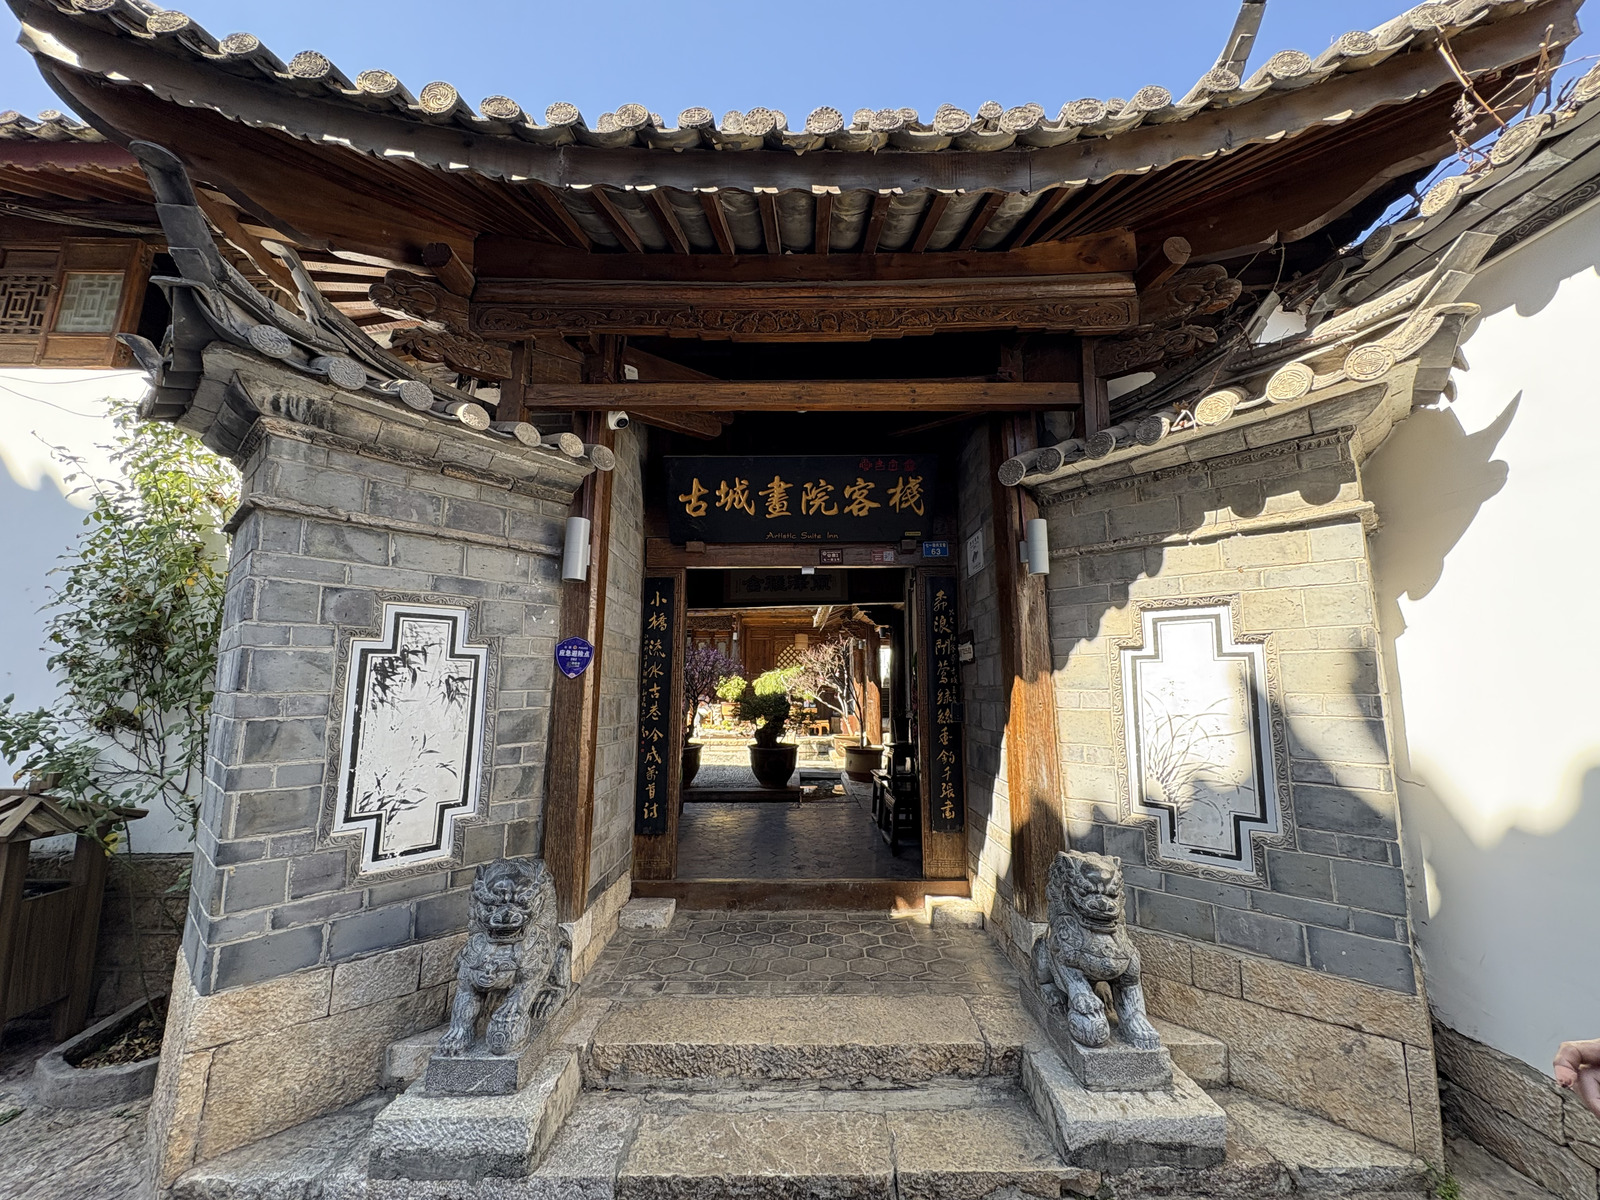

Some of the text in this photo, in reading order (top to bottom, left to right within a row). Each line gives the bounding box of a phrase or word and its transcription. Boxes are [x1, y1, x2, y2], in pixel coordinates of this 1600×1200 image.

[678, 475, 925, 519] 古城畫院客棧
[765, 531, 839, 540] Artistic Suite Inn
[931, 548, 941, 556] 63
